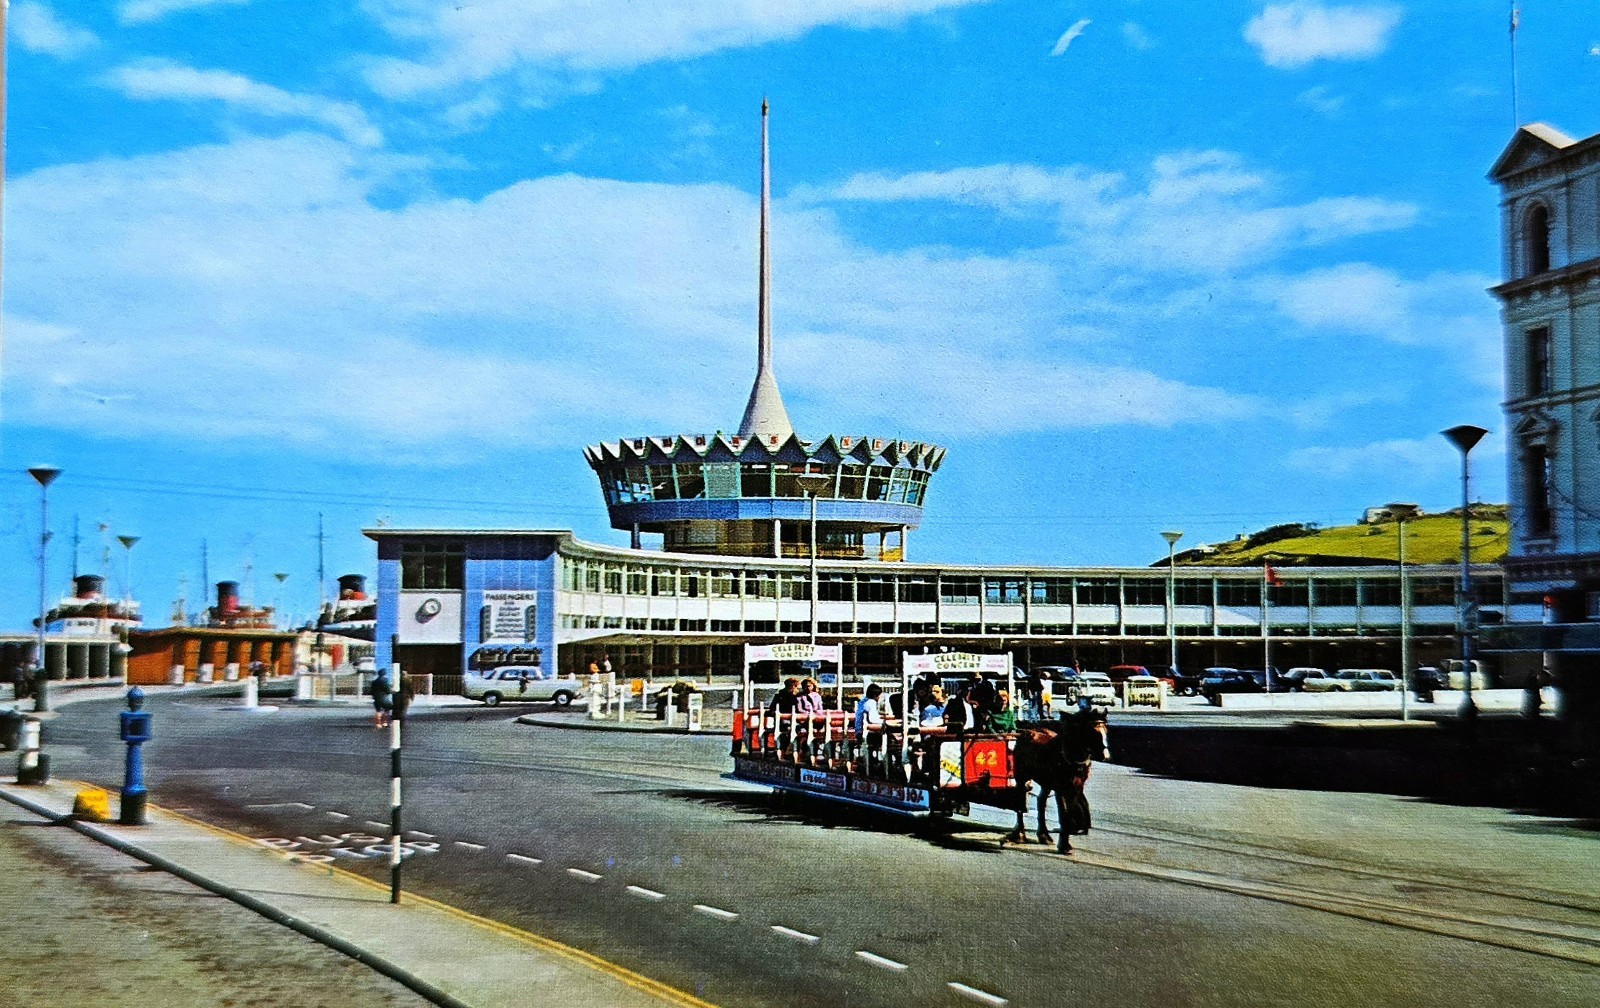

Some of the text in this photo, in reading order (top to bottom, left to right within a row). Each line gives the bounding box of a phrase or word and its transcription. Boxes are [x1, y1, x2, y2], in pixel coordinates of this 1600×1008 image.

[771, 644, 816, 653] CELEBRITY
[934, 653, 982, 663] CELEBRITY
[975, 750, 998, 766] 42
[258, 832, 386, 849] BUS
[290, 841, 441, 863] STOP
